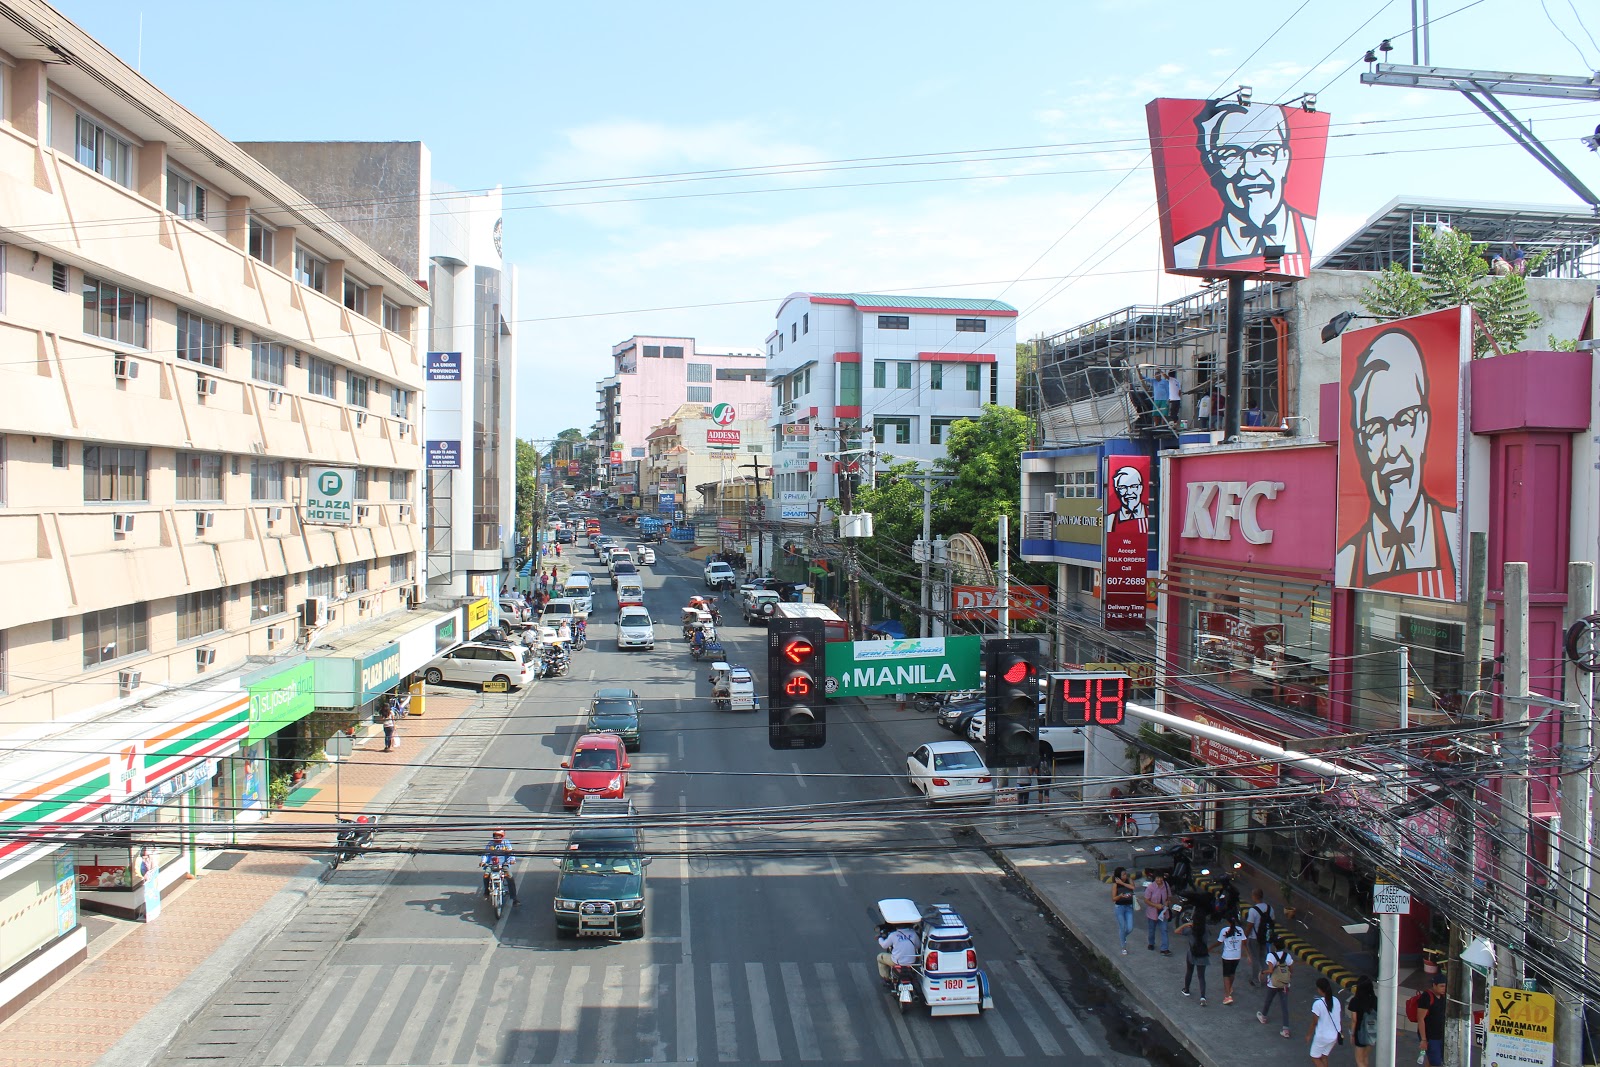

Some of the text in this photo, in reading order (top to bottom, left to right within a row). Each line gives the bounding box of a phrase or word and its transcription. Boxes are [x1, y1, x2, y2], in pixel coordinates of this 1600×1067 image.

[708, 431, 740, 440] ADDESSA
[308, 499, 351, 509] PLAZA
[308, 510, 351, 520] HOTEL
[1181, 481, 1279, 545] KFC
[1069, 515, 1082, 525] HOME
[1082, 516, 1098, 527] CENTRE
[1107, 577, 1146, 586] 607-2689
[362, 661, 383, 693] PLAZA
[854, 663, 957, 687] MANILA
[786, 676, 808, 694] 25
[1063, 678, 1124, 724] 48
[1385, 886, 1399, 894] KEEP
[1385, 904, 1399, 912] OPEN
[944, 980, 963, 989] 1620
[1502, 991, 1532, 1002] GET
[1490, 1025, 1512, 1035] AYAW
[1514, 1029, 1524, 1037] SA
[1494, 1018, 1547, 1033] MAMAMAYAN
[1518, 1057, 1544, 1065] HOTLINE
